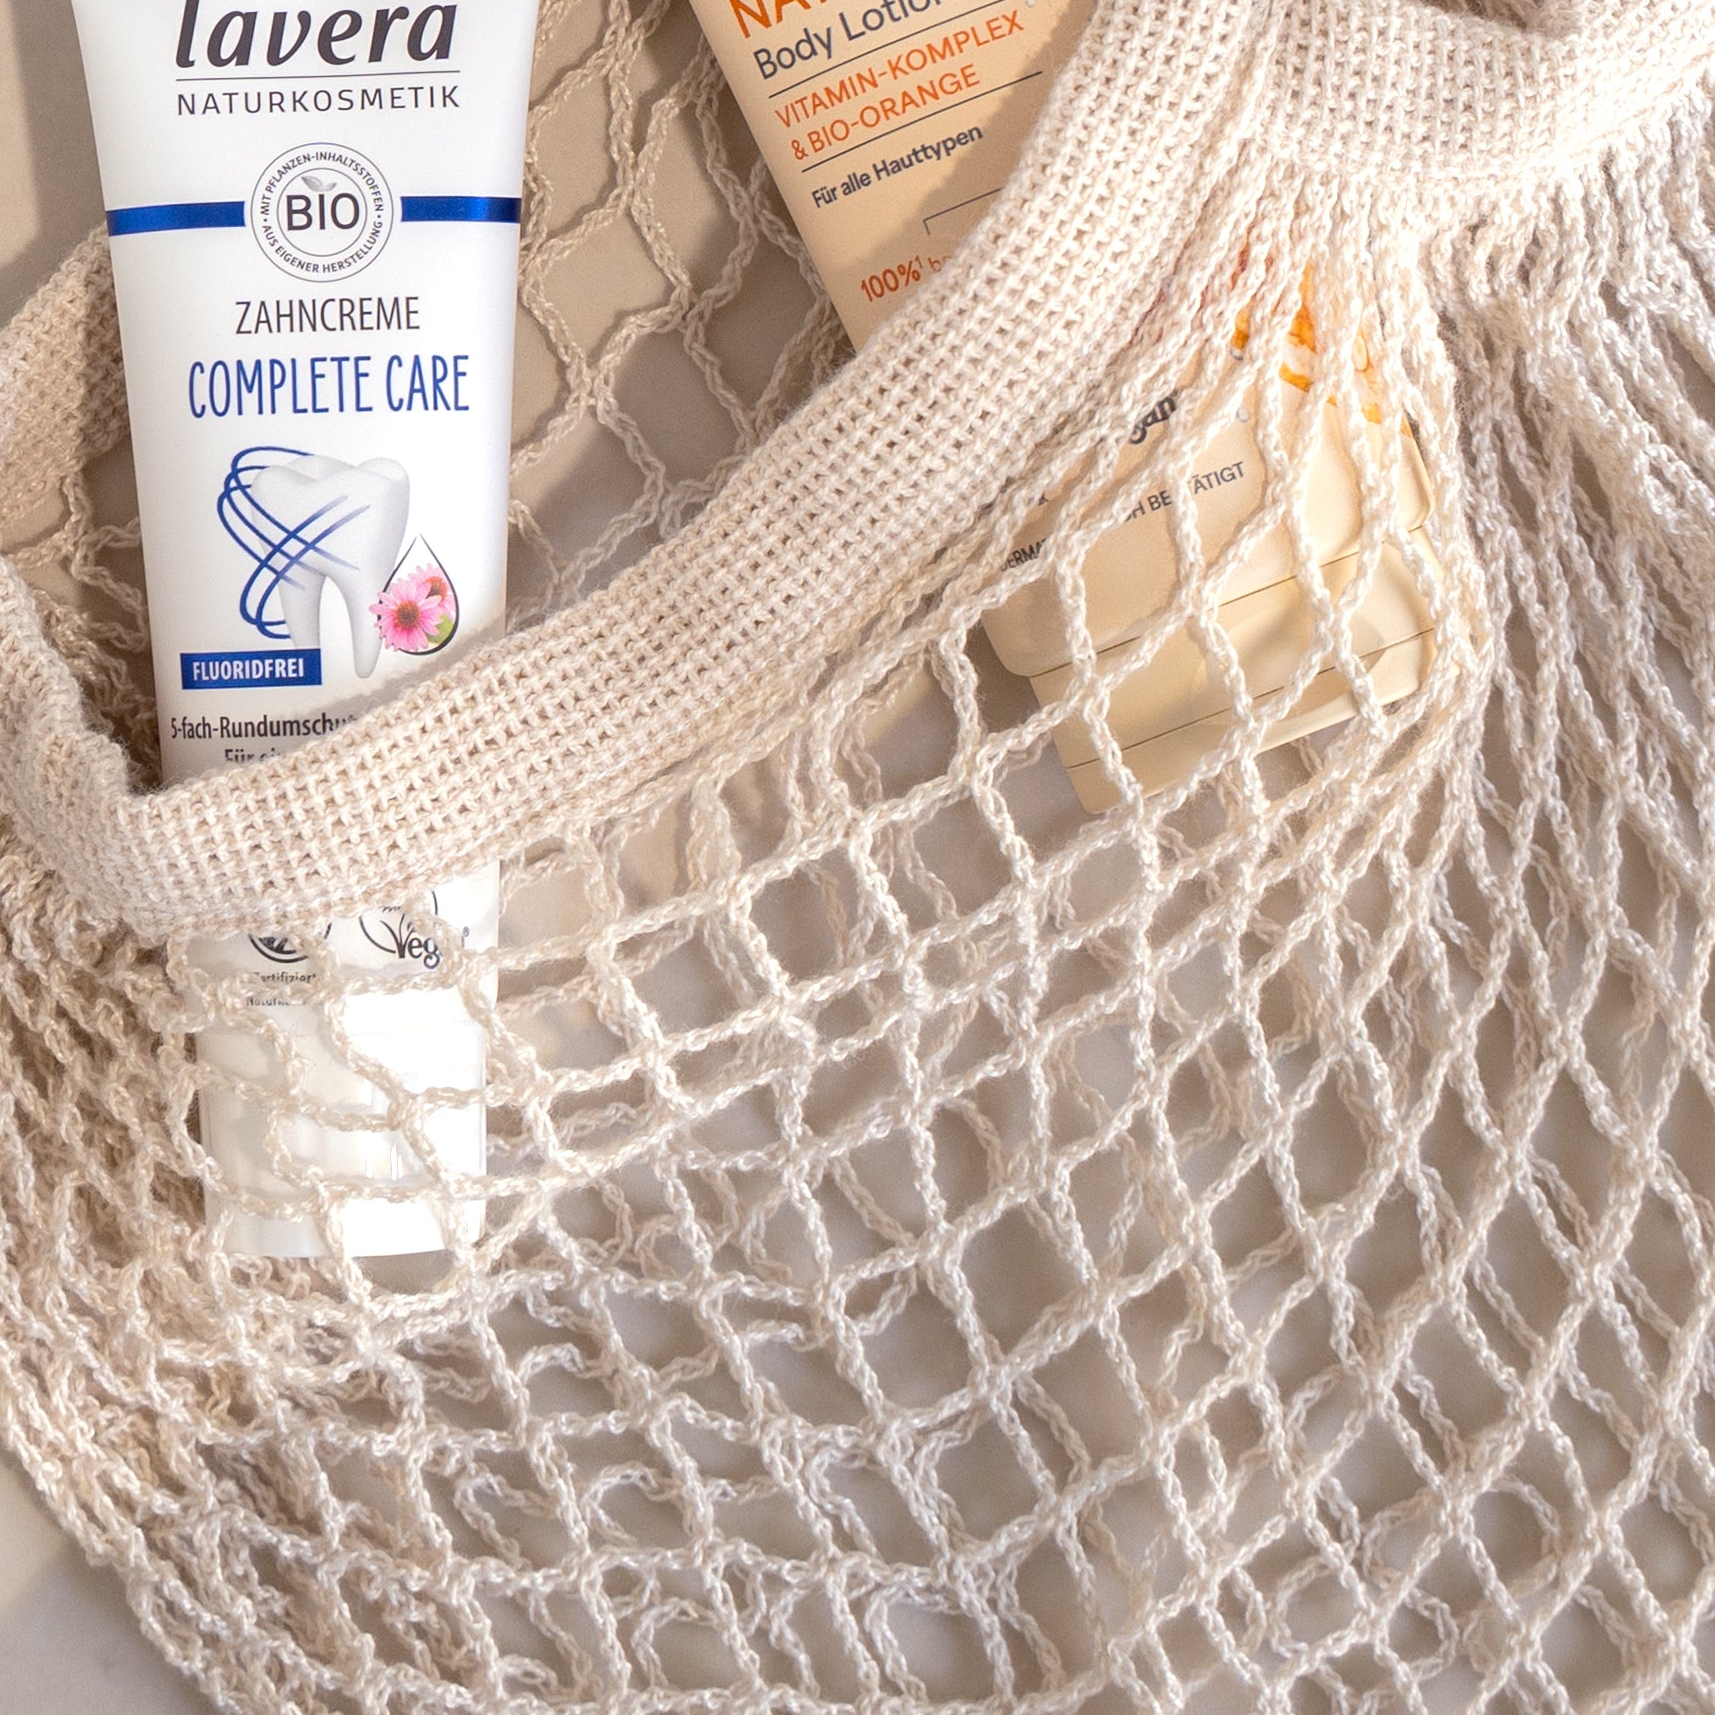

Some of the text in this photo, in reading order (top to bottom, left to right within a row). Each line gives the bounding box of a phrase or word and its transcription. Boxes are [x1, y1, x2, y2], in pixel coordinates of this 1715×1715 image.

[752, 26, 834, 80] Body
[774, 10, 1024, 129] VITAMIN-KOMPLEX
[177, 85, 461, 116] NATURKOSMETIK
[790, 64, 981, 161] & BIO-ORANGE
[260, 152, 384, 216] MIT PFLANZEN-INHALTSSTOFFEN
[811, 125, 984, 208] Für alle Hauttypen
[286, 192, 360, 231] BIO
[262, 221, 383, 273] AUS EIGENER HERSTELLUNG
[234, 296, 421, 335] ZAHNCREME
[188, 354, 470, 419] COMPLETE CARE
[1148, 461, 1245, 513] BEÄTIGT
[192, 658, 305, 682] FLUORIDFREI
